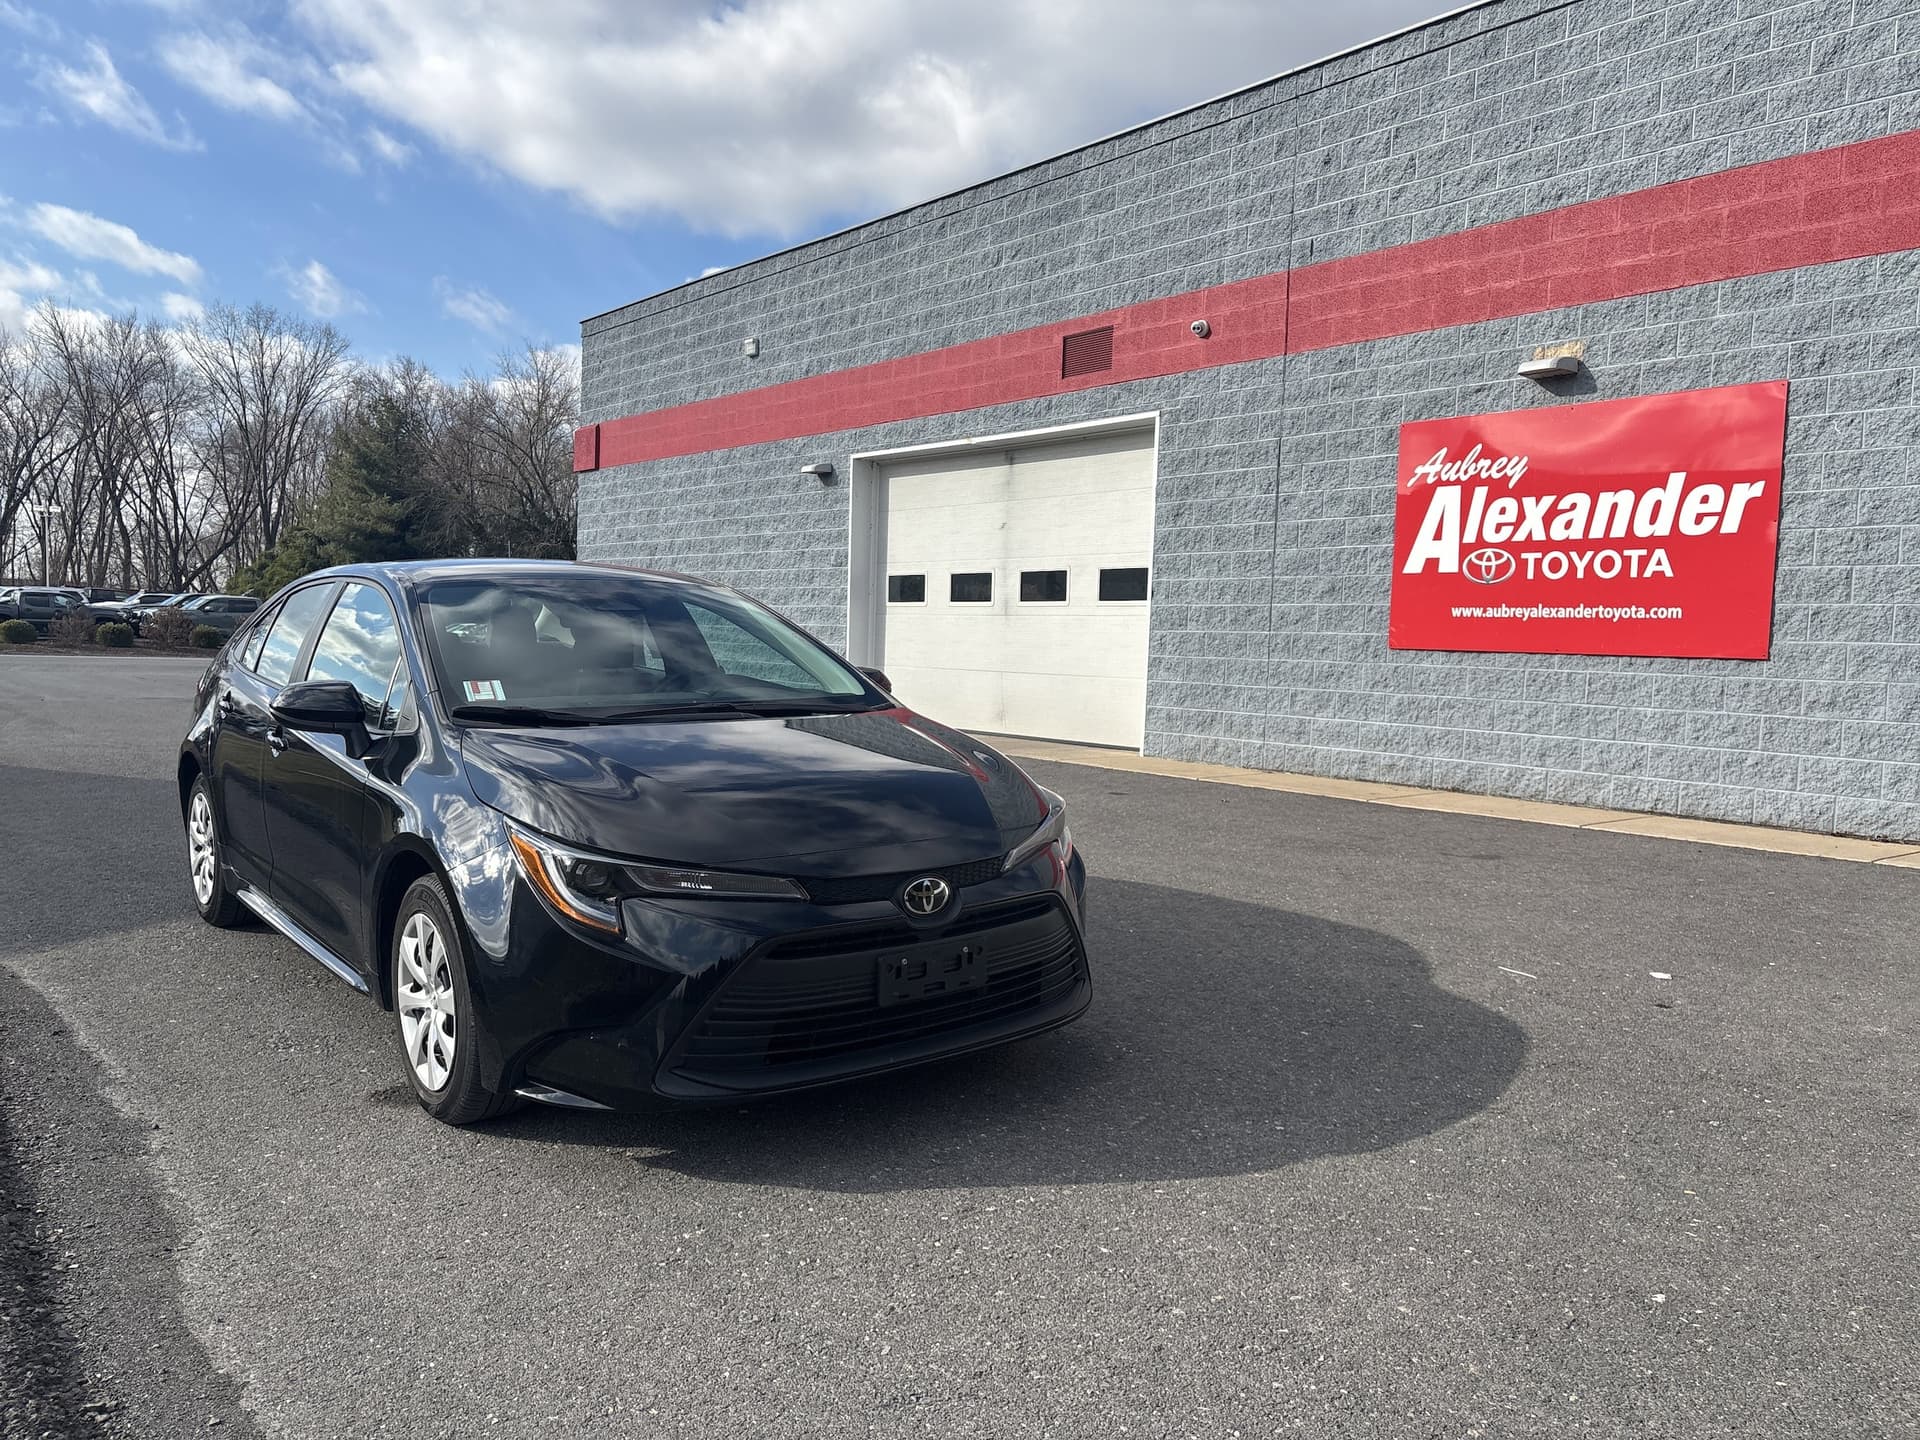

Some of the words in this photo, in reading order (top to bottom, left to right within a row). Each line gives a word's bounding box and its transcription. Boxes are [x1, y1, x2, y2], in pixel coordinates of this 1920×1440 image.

[1407, 443, 1528, 488] Aubrey
[1403, 471, 1766, 574] Alexander
[1520, 548, 1674, 580] TOYOTA
[1451, 603, 1683, 622] www.aubreyalexandertoyota.com
